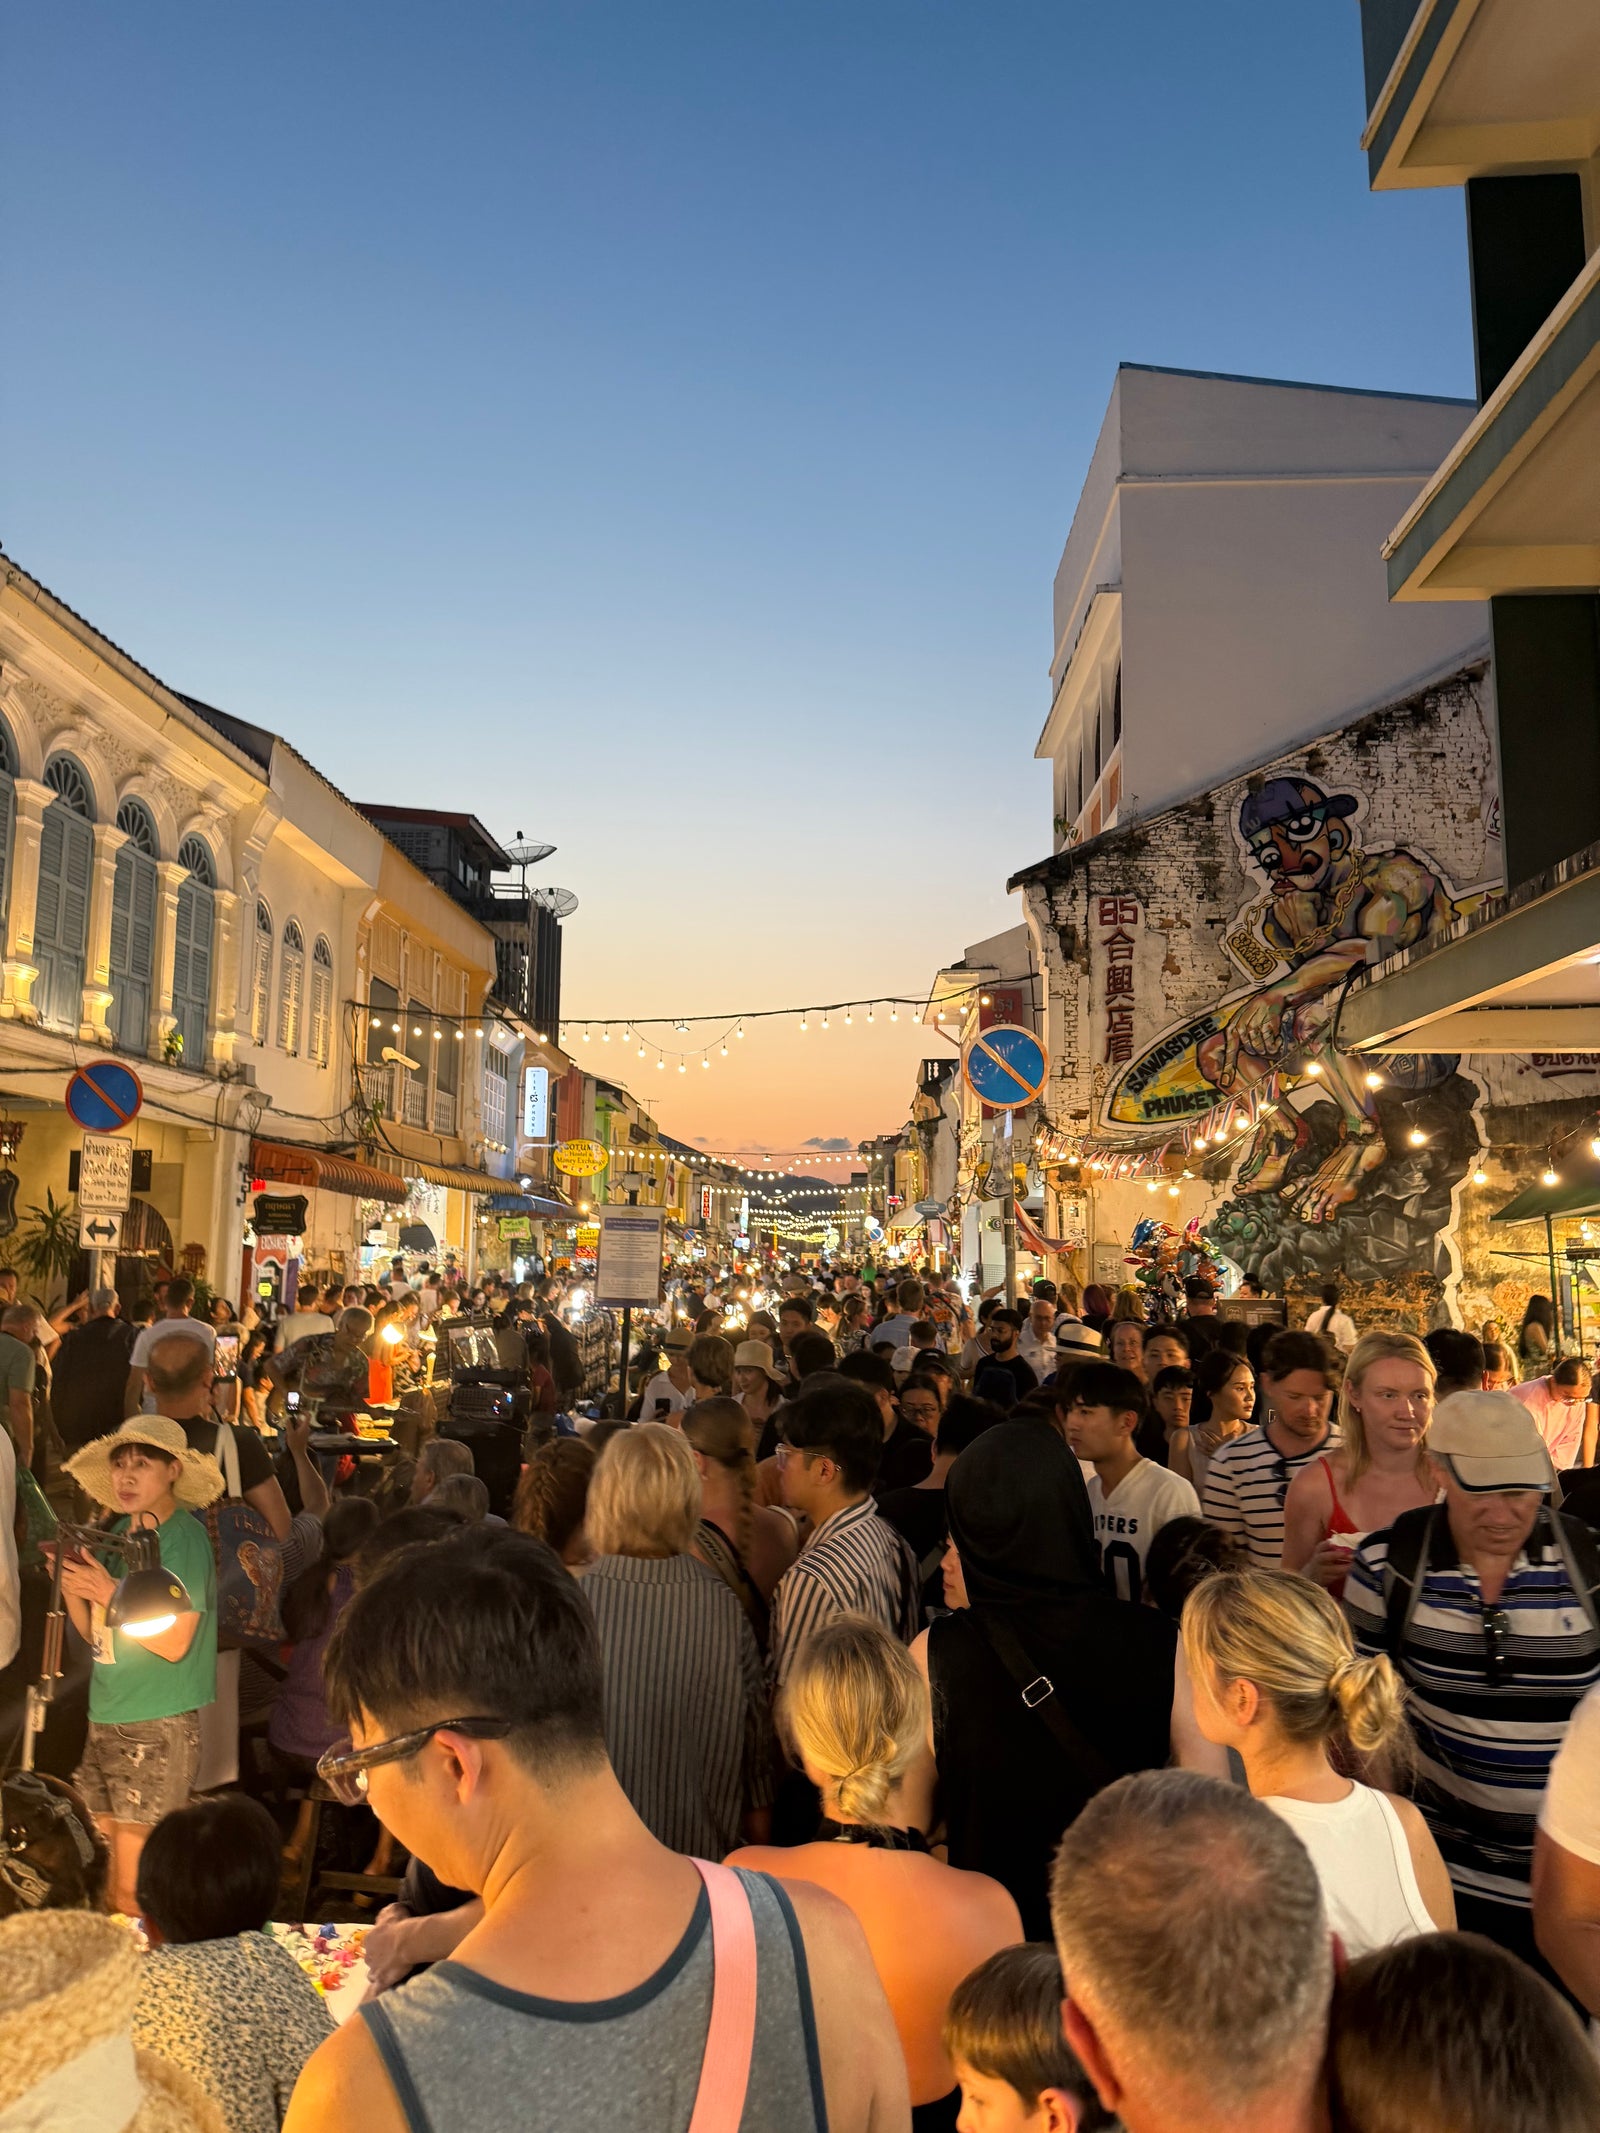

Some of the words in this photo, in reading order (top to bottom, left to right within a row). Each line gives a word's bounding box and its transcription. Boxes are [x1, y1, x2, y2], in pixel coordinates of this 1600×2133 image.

[1099, 897, 1138, 926] 85
[1125, 1016, 1218, 1095] SAWASDEE
[1143, 1087, 1222, 1118] PHUKET
